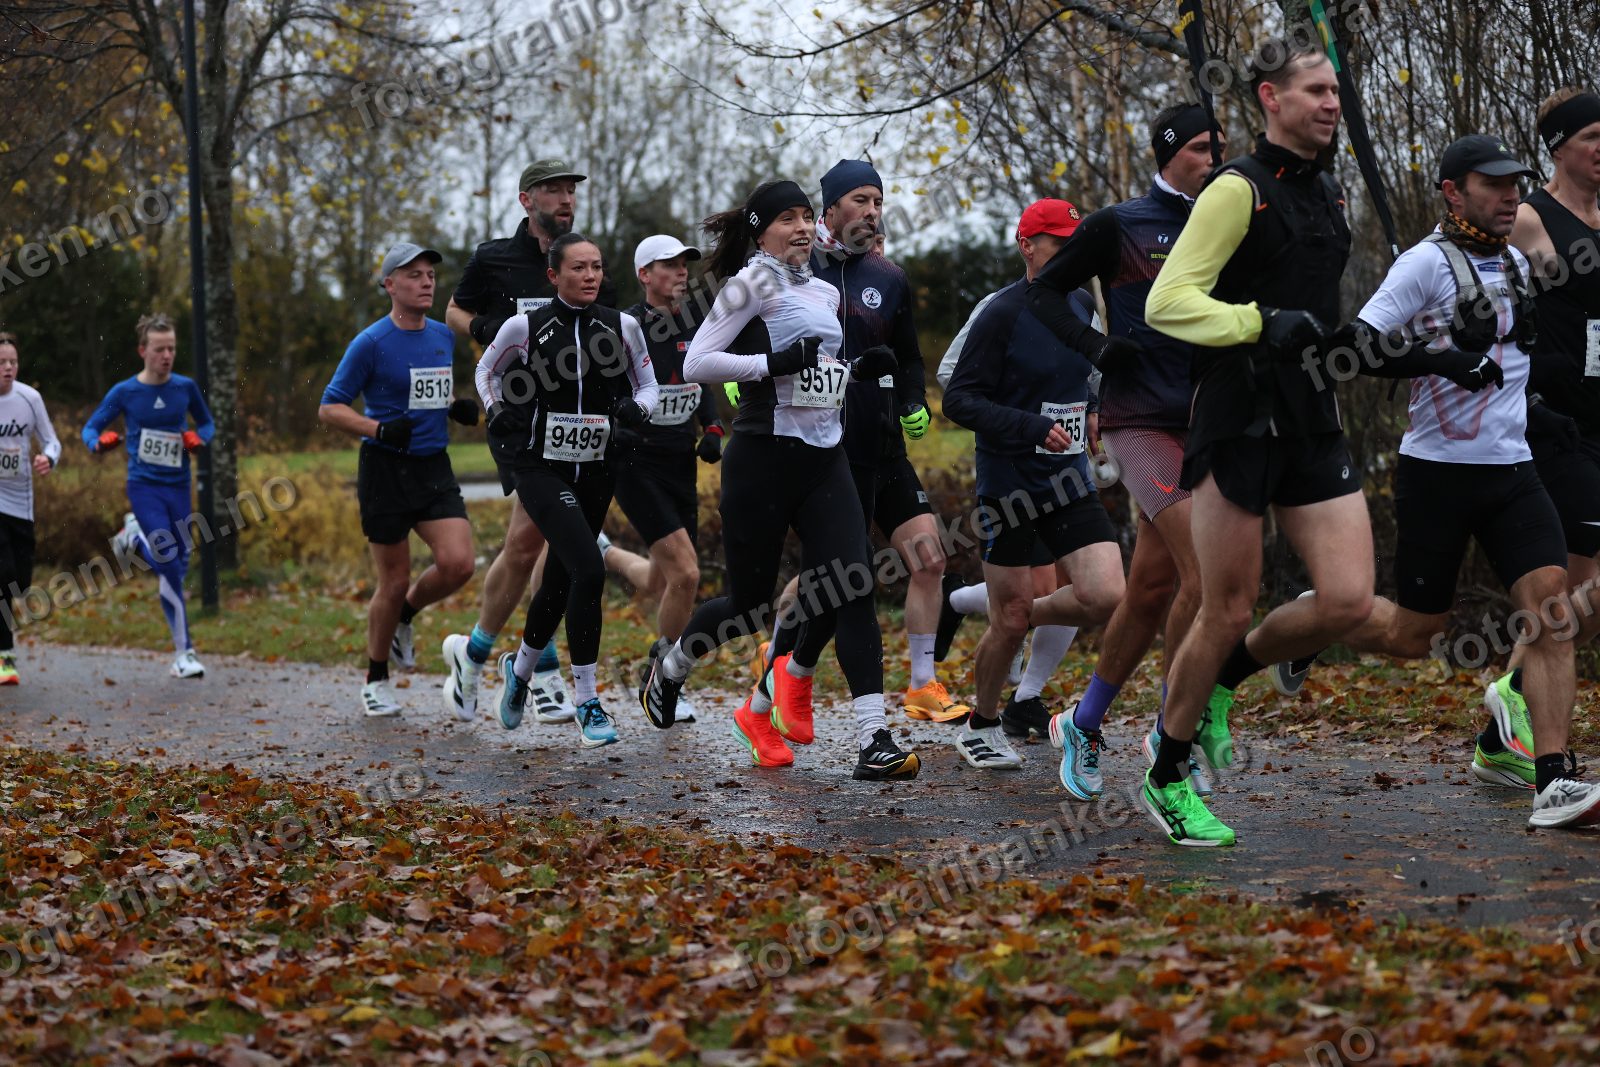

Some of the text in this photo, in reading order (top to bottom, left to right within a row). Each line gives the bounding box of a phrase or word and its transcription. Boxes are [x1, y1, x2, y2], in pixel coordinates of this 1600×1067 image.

[414, 378, 450, 399] 9513
[799, 366, 845, 395] 9517
[659, 392, 697, 416] 1173
[552, 416, 606, 424] NORGESTESTEN
[551, 425, 605, 450] 9495
[143, 438, 180, 459] 9514
[0, 454, 20, 470] 08
